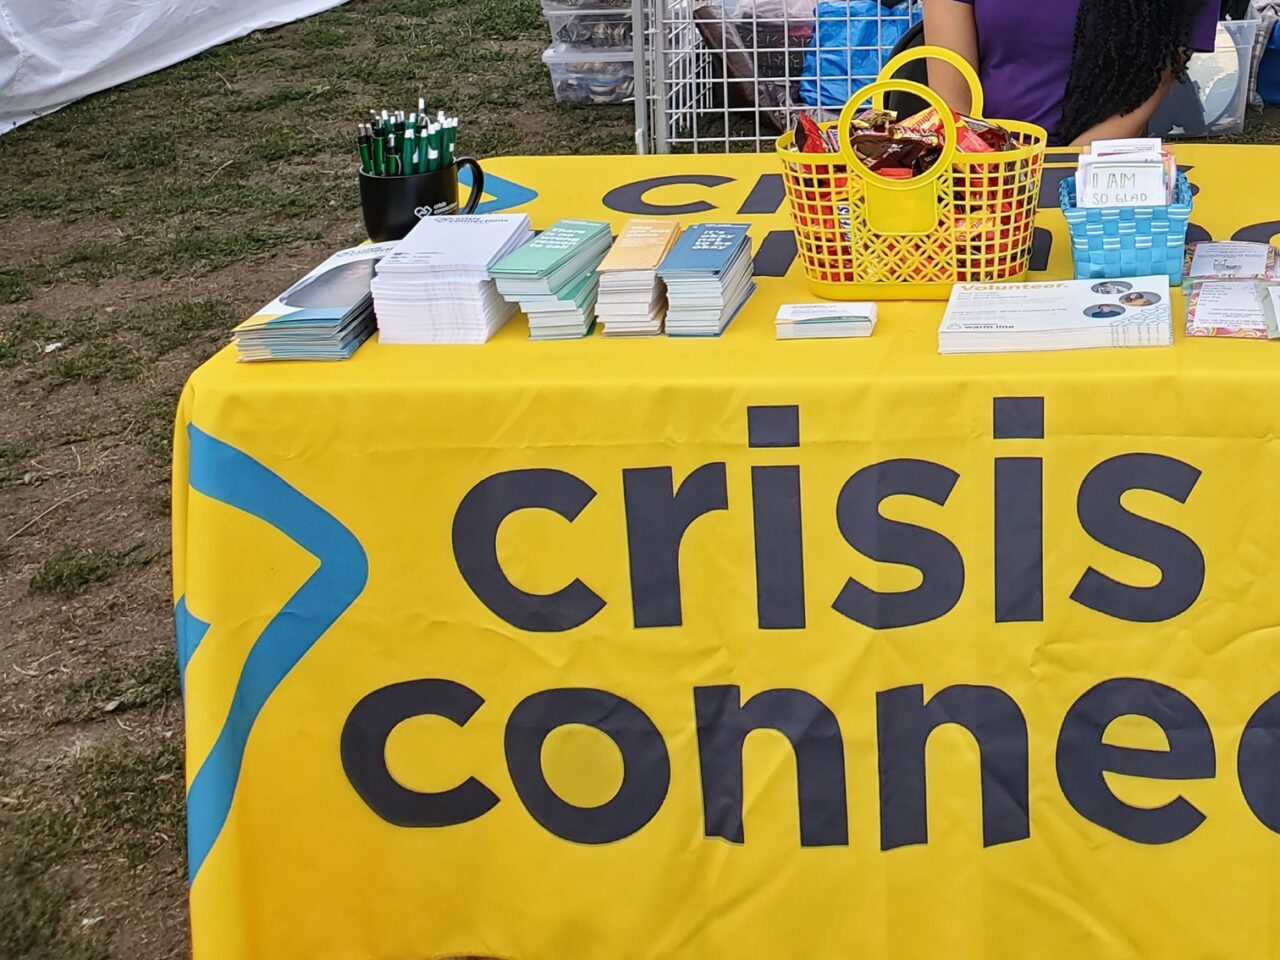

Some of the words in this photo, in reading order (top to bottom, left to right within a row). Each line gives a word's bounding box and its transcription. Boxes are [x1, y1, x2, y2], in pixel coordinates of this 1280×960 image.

[1107, 173, 1136, 189] AM
[1092, 193, 1109, 205] SO
[1116, 193, 1148, 204] GLAD
[961, 283, 1069, 291] Volunteer.
[452, 397, 1205, 632] crisis
